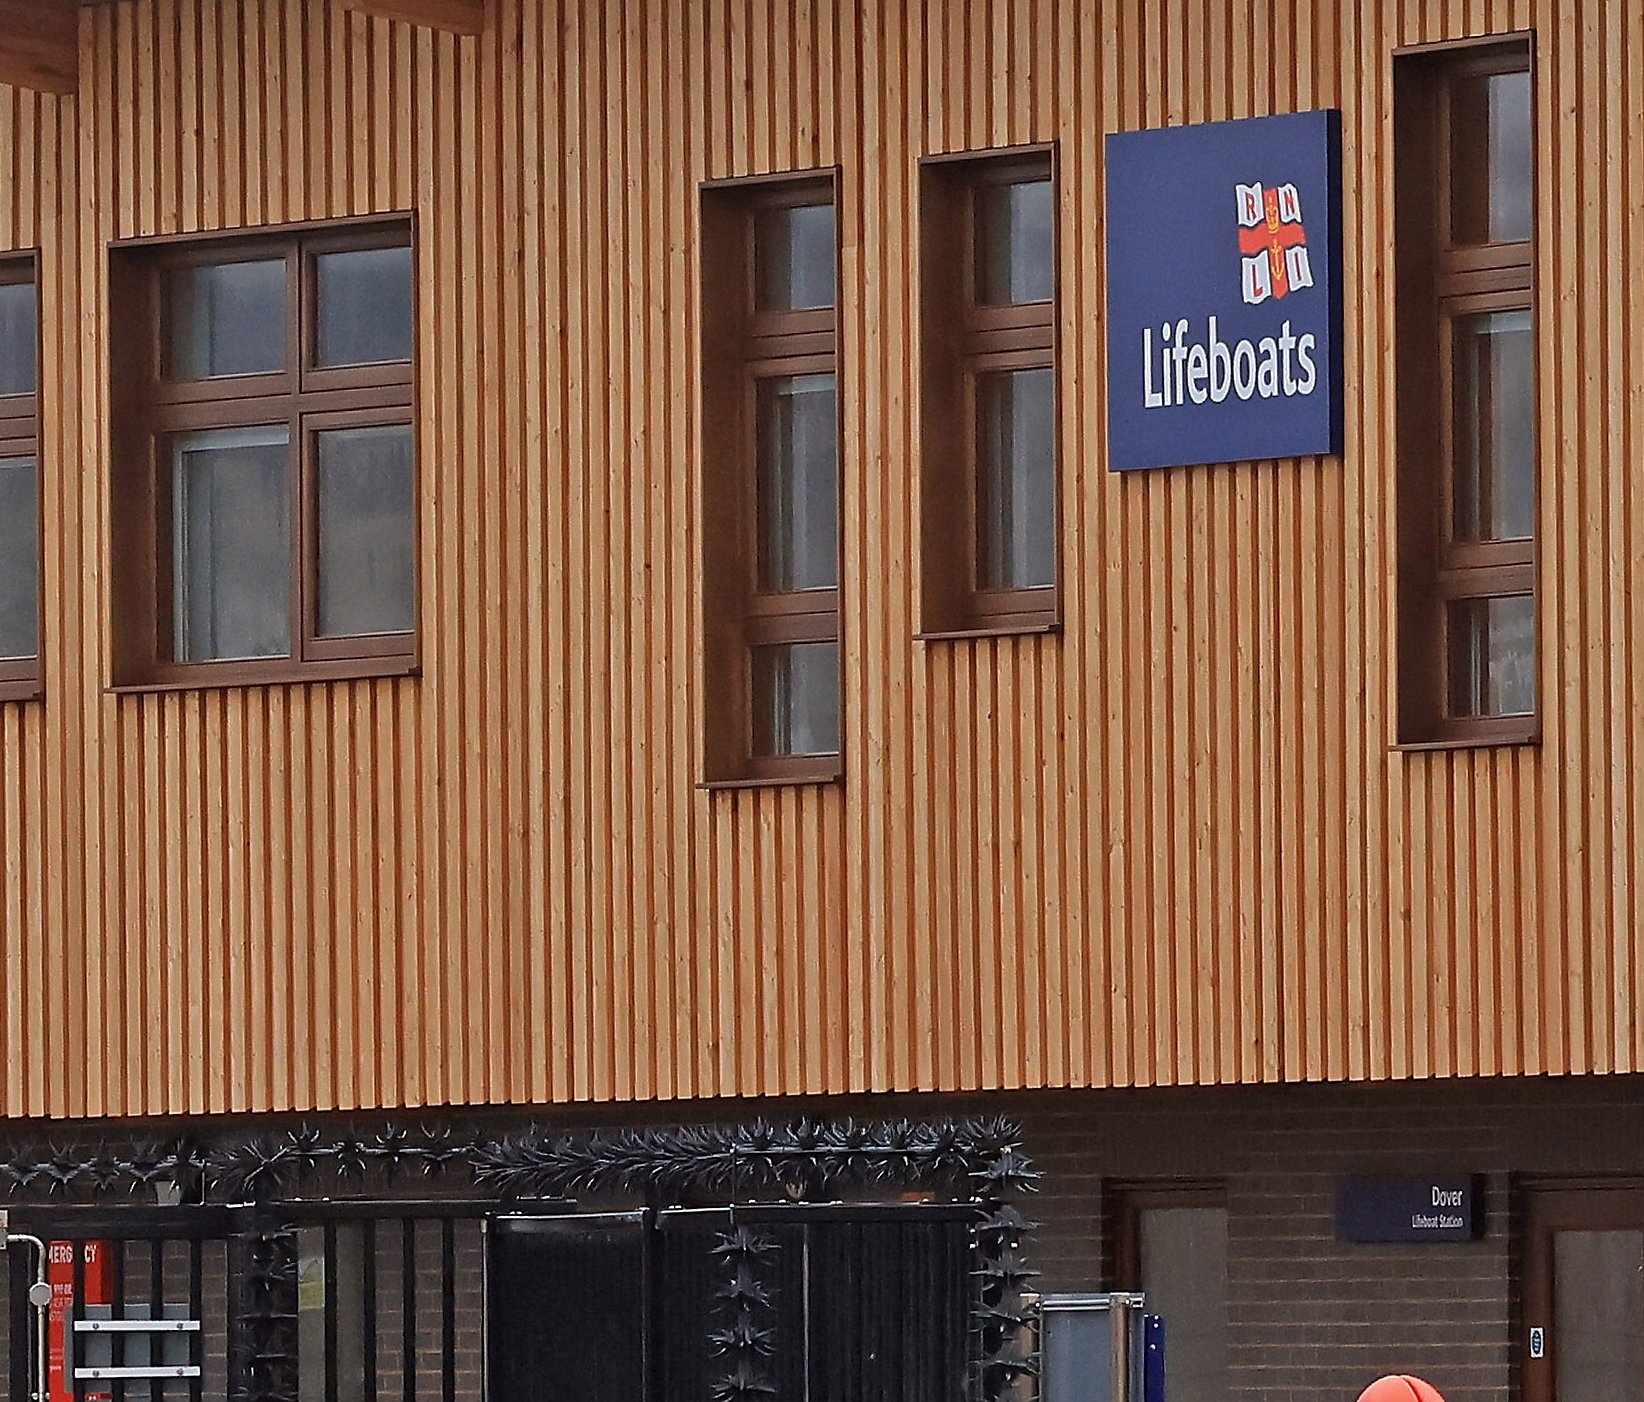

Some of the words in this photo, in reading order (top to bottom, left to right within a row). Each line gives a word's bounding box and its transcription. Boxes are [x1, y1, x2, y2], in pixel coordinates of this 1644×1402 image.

[1143, 316, 1317, 409] Lifeboats
[1431, 1186, 1463, 1207] Dover
[1412, 1214, 1438, 1228] Lifeboat
[1439, 1214, 1463, 1228] Station
[49, 1245, 97, 1263] ERGCY
